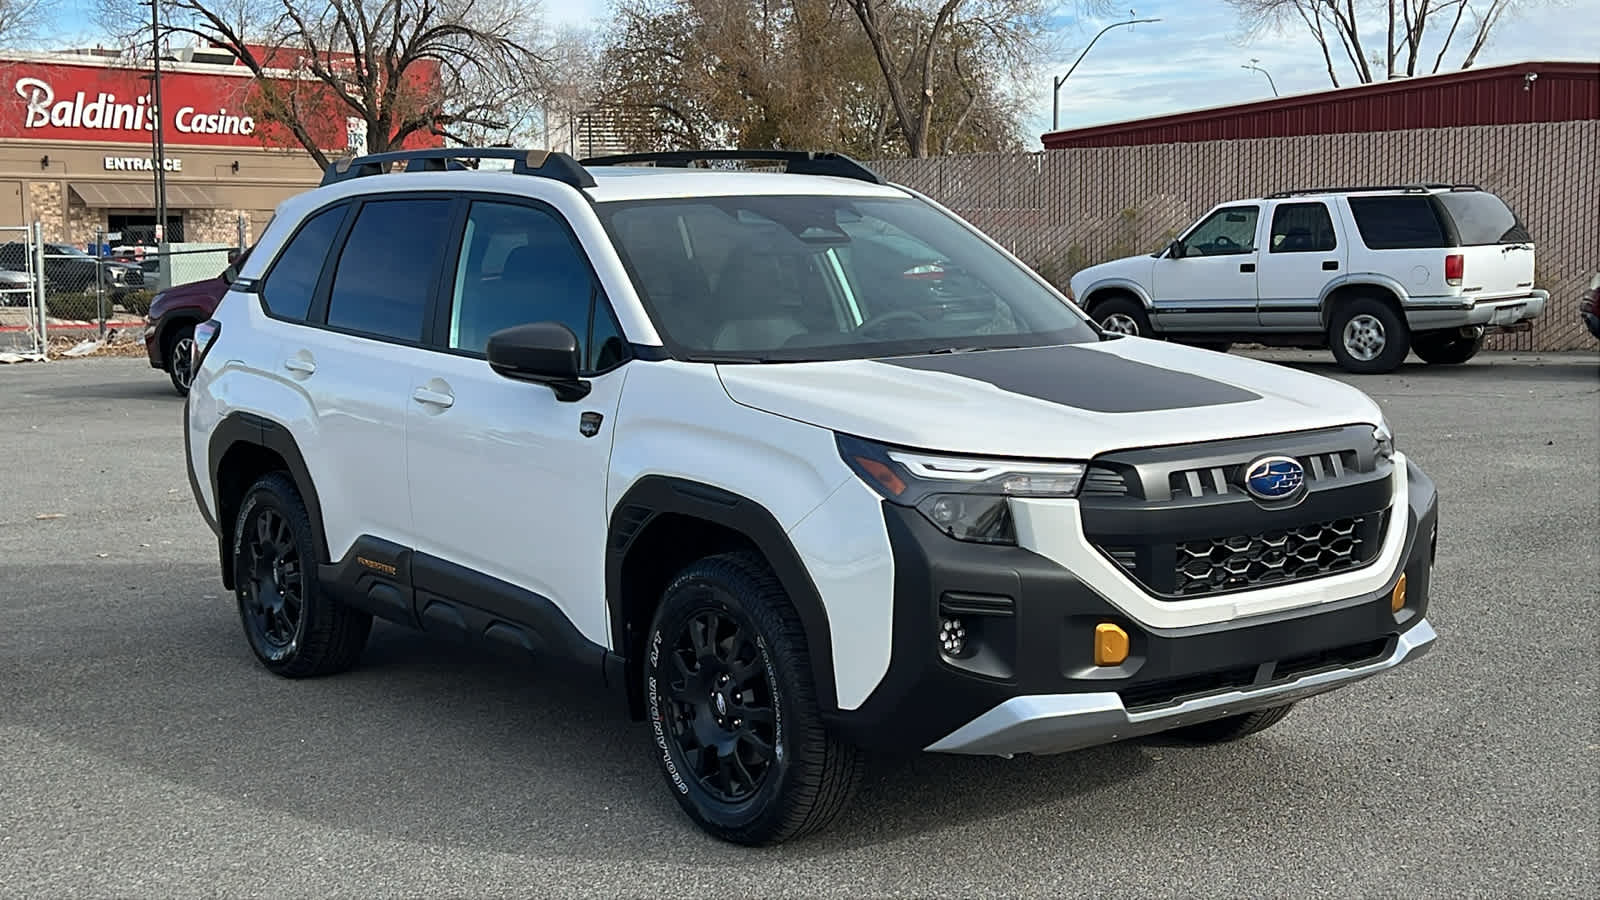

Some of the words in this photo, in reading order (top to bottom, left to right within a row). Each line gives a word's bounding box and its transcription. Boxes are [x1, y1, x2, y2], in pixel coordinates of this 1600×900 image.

[15, 77, 159, 131] Baldini's
[175, 107, 255, 135] Casino
[649, 676, 689, 795] GEOLANDAR
